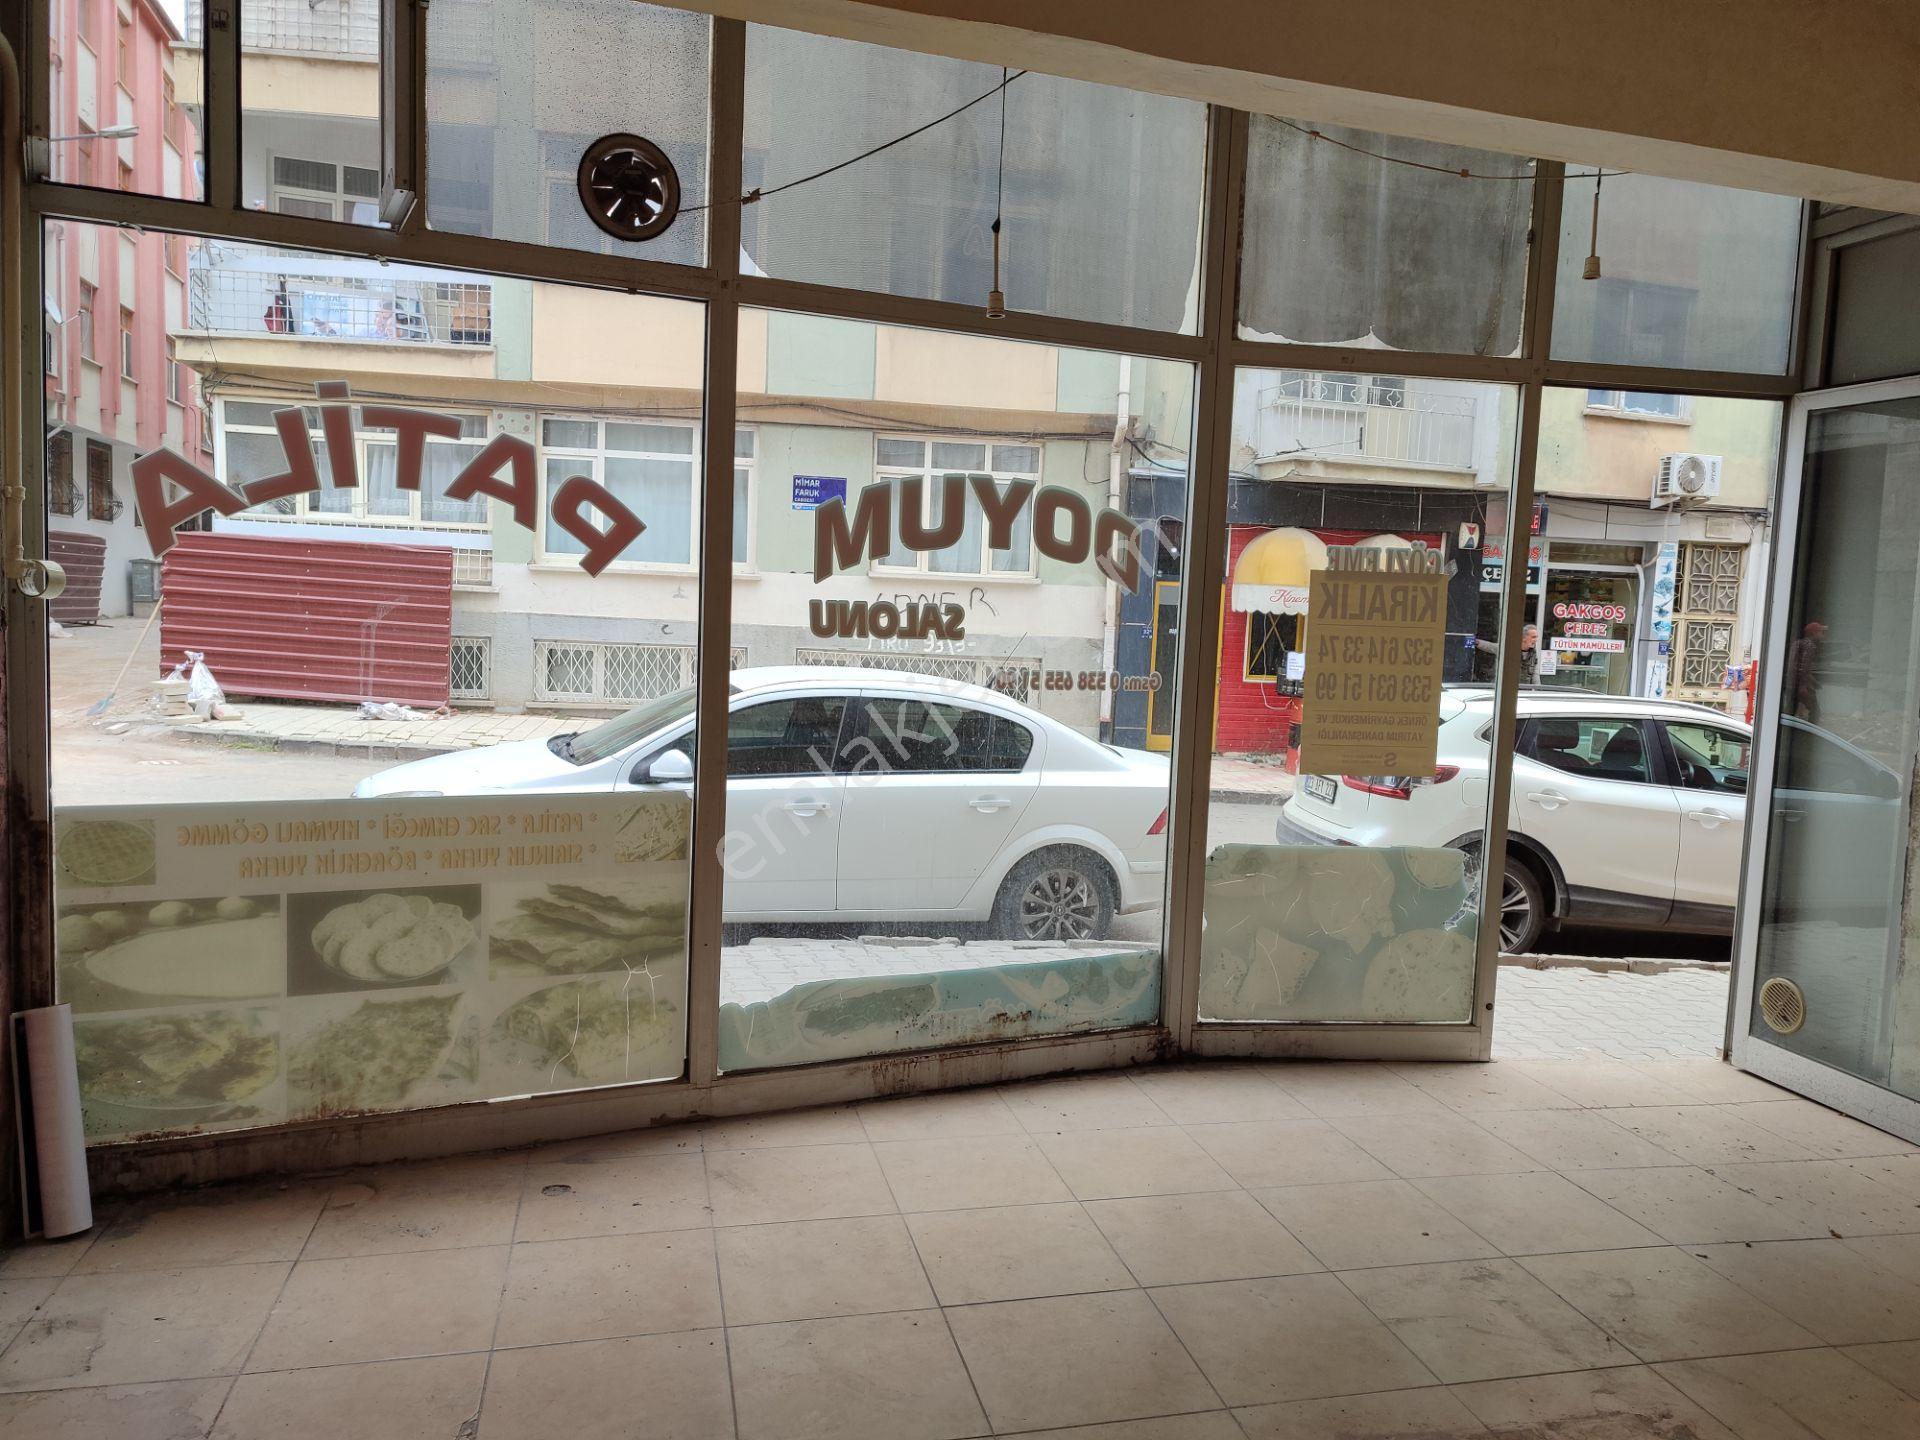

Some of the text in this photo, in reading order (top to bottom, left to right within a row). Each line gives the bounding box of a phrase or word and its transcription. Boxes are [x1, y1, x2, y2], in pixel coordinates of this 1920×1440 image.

[795, 488, 819, 497] FARUK
[1553, 603, 1626, 623] GAKGOŞ
[1564, 622, 1607, 637] ÇEREZ
